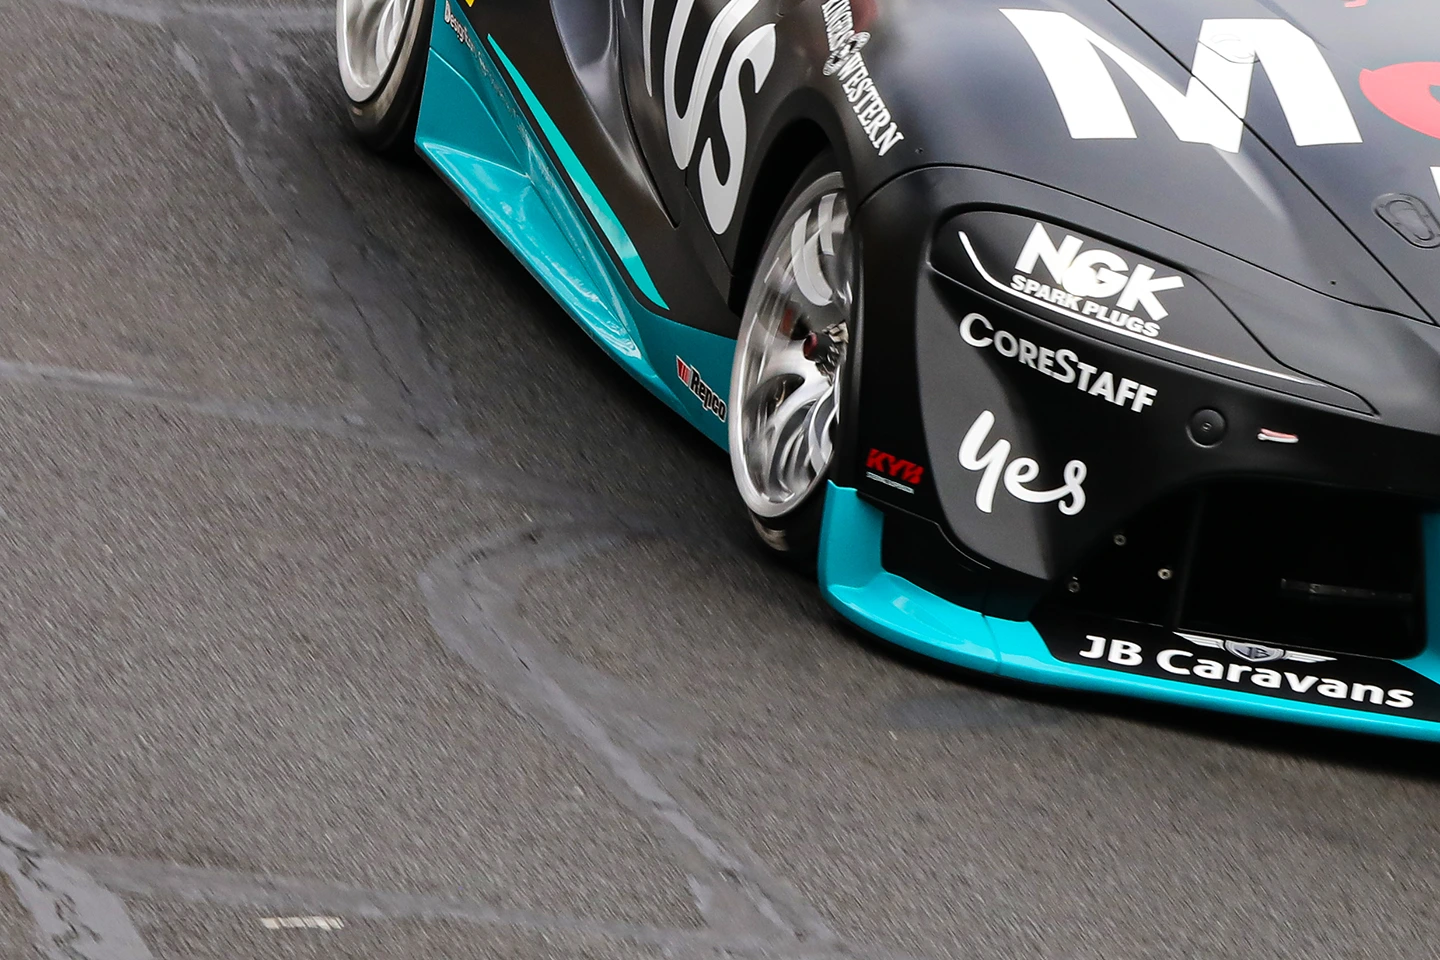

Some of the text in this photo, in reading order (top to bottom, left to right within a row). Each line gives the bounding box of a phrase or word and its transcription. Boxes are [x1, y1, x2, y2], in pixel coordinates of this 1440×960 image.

[838, 54, 904, 156] WESTERN
[1010, 274, 1161, 338] SPARK PLUGS
[1014, 221, 1185, 322] NGK
[689, 365, 727, 422] Repco
[865, 448, 924, 484] KYB
[958, 409, 1087, 516] yes
[1079, 634, 1415, 709] JB Caravans
